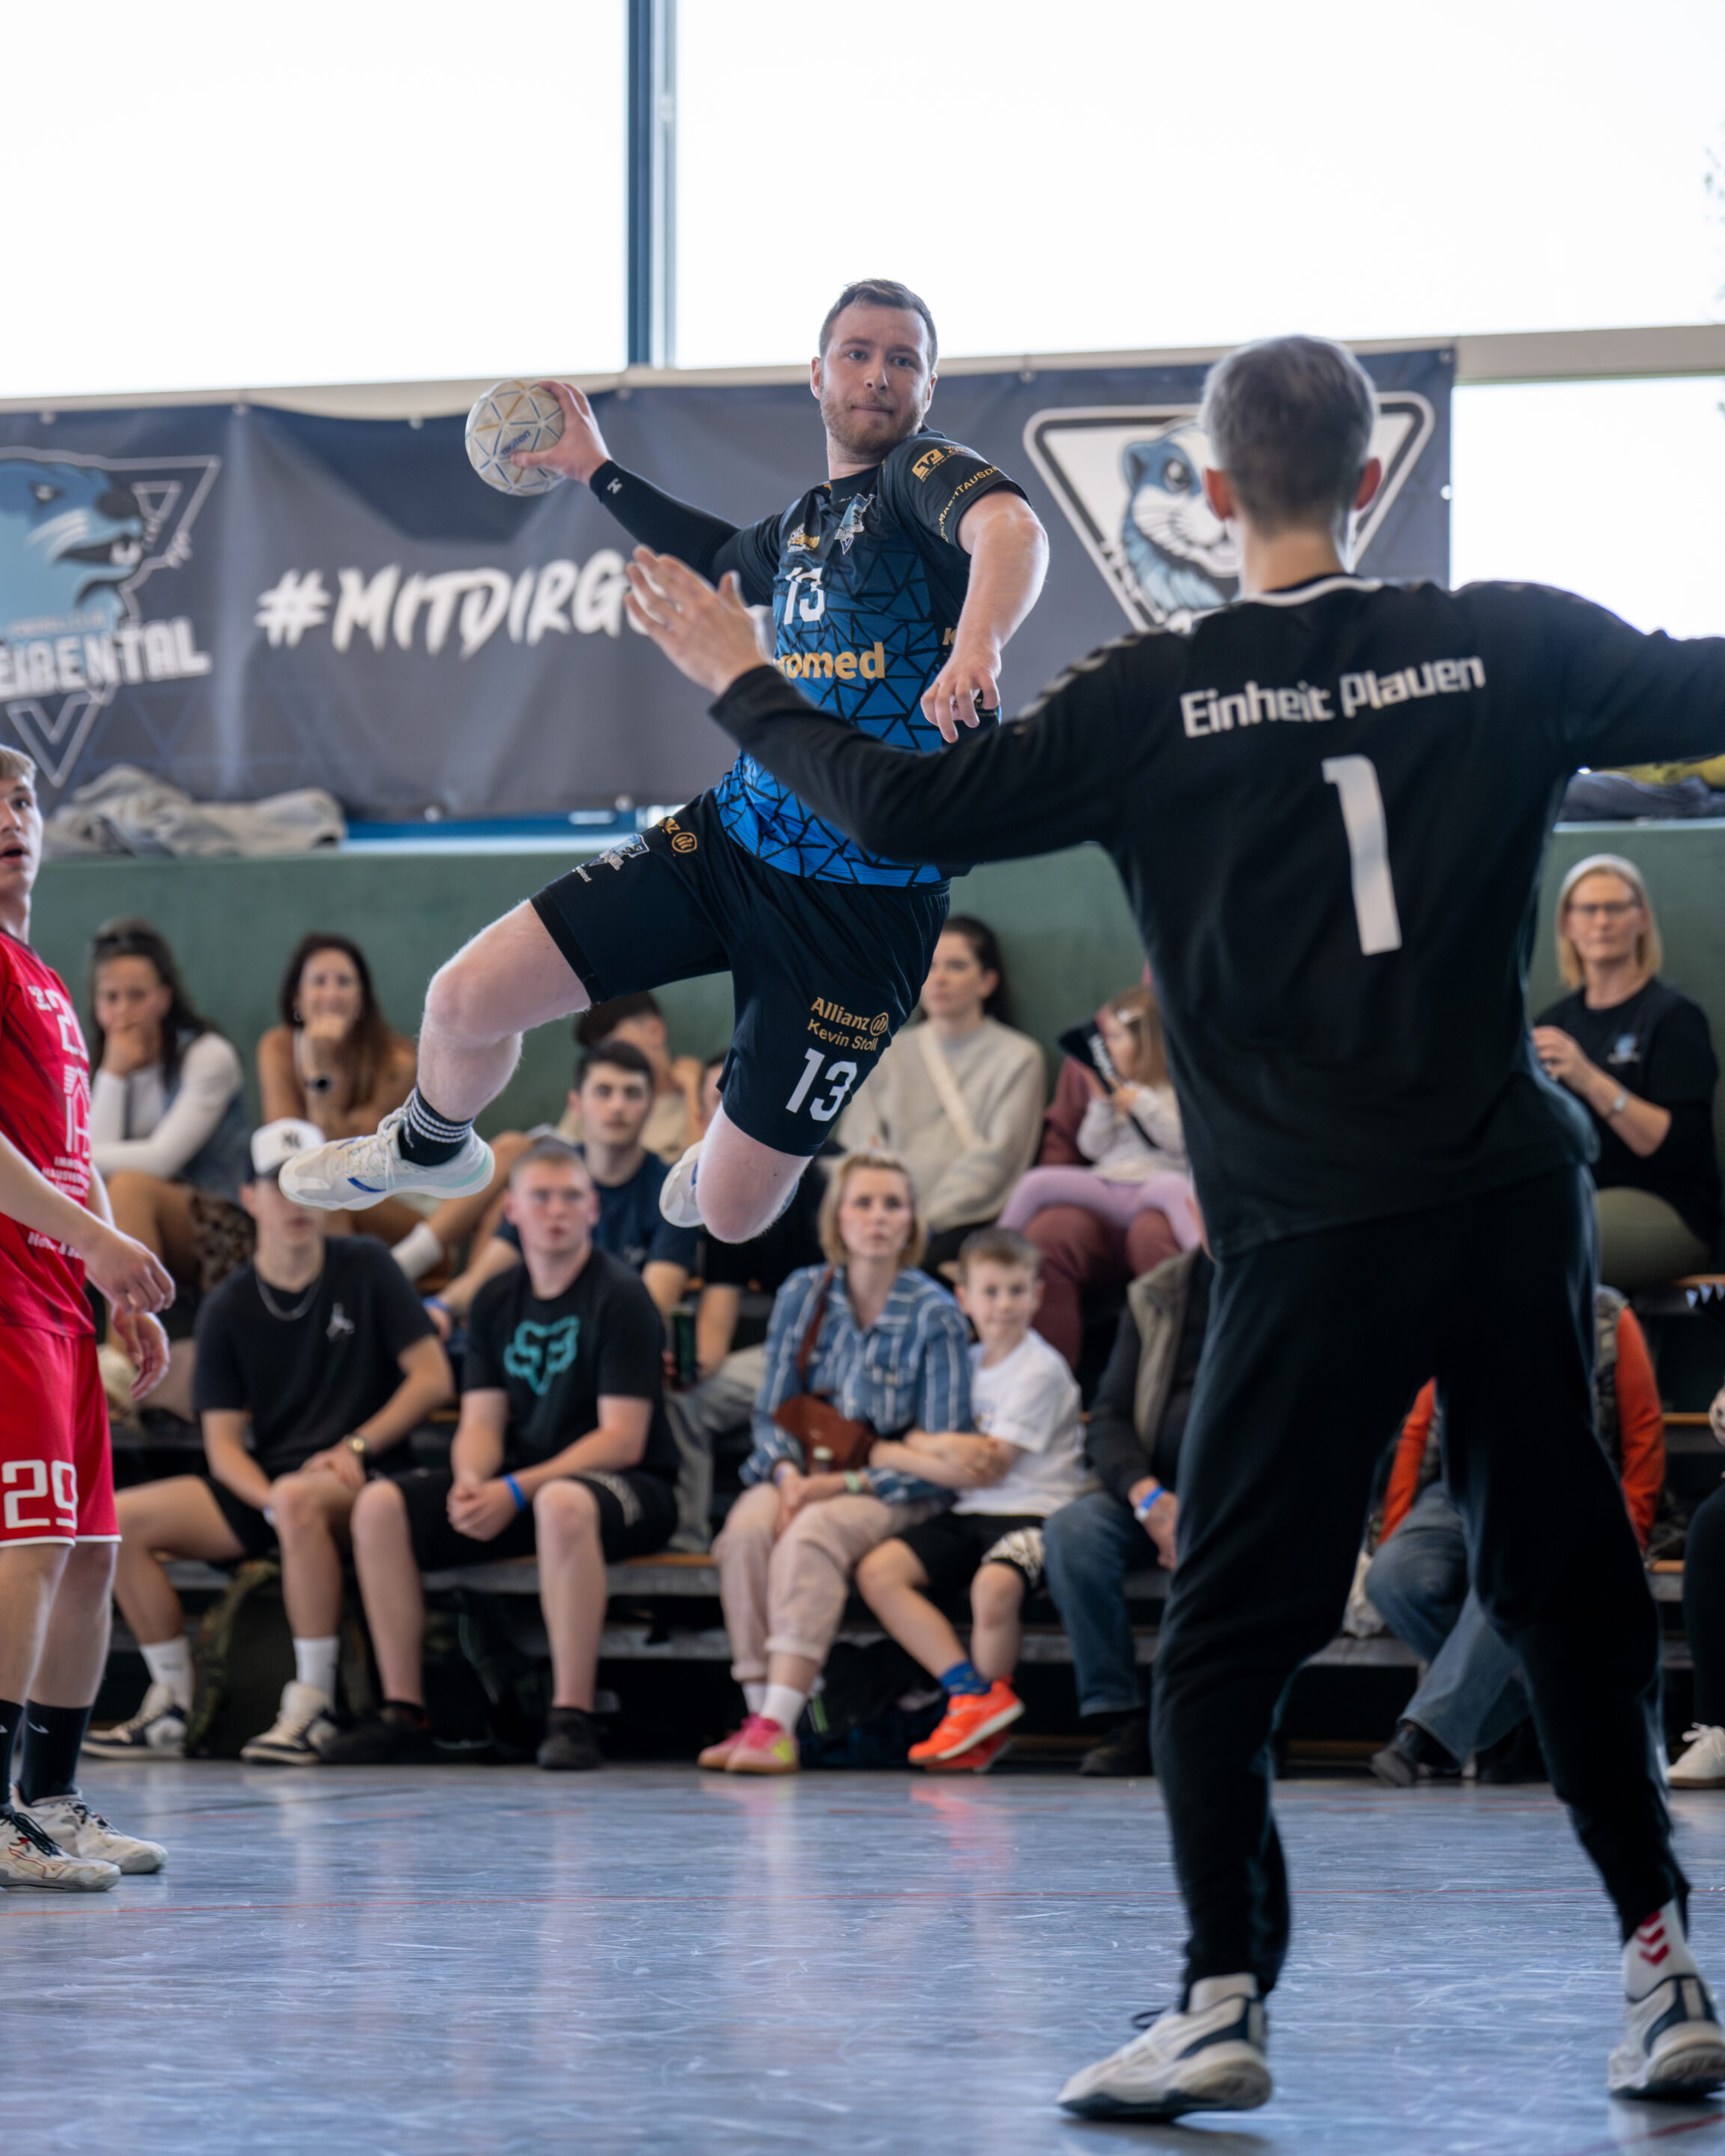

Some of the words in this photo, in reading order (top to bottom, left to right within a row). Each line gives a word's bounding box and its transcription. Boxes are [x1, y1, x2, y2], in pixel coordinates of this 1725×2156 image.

[254, 549, 650, 660] #MITDIRG
[784, 567, 825, 624] 13
[1180, 680, 1335, 738] Einheit
[1321, 754, 1402, 957] 1
[807, 1018, 850, 1047] Kevin
[851, 1035, 879, 1051] Stoll
[810, 996, 871, 1030] Allianz
[785, 1048, 857, 1122] 13
[1, 1459, 79, 1529] 29
